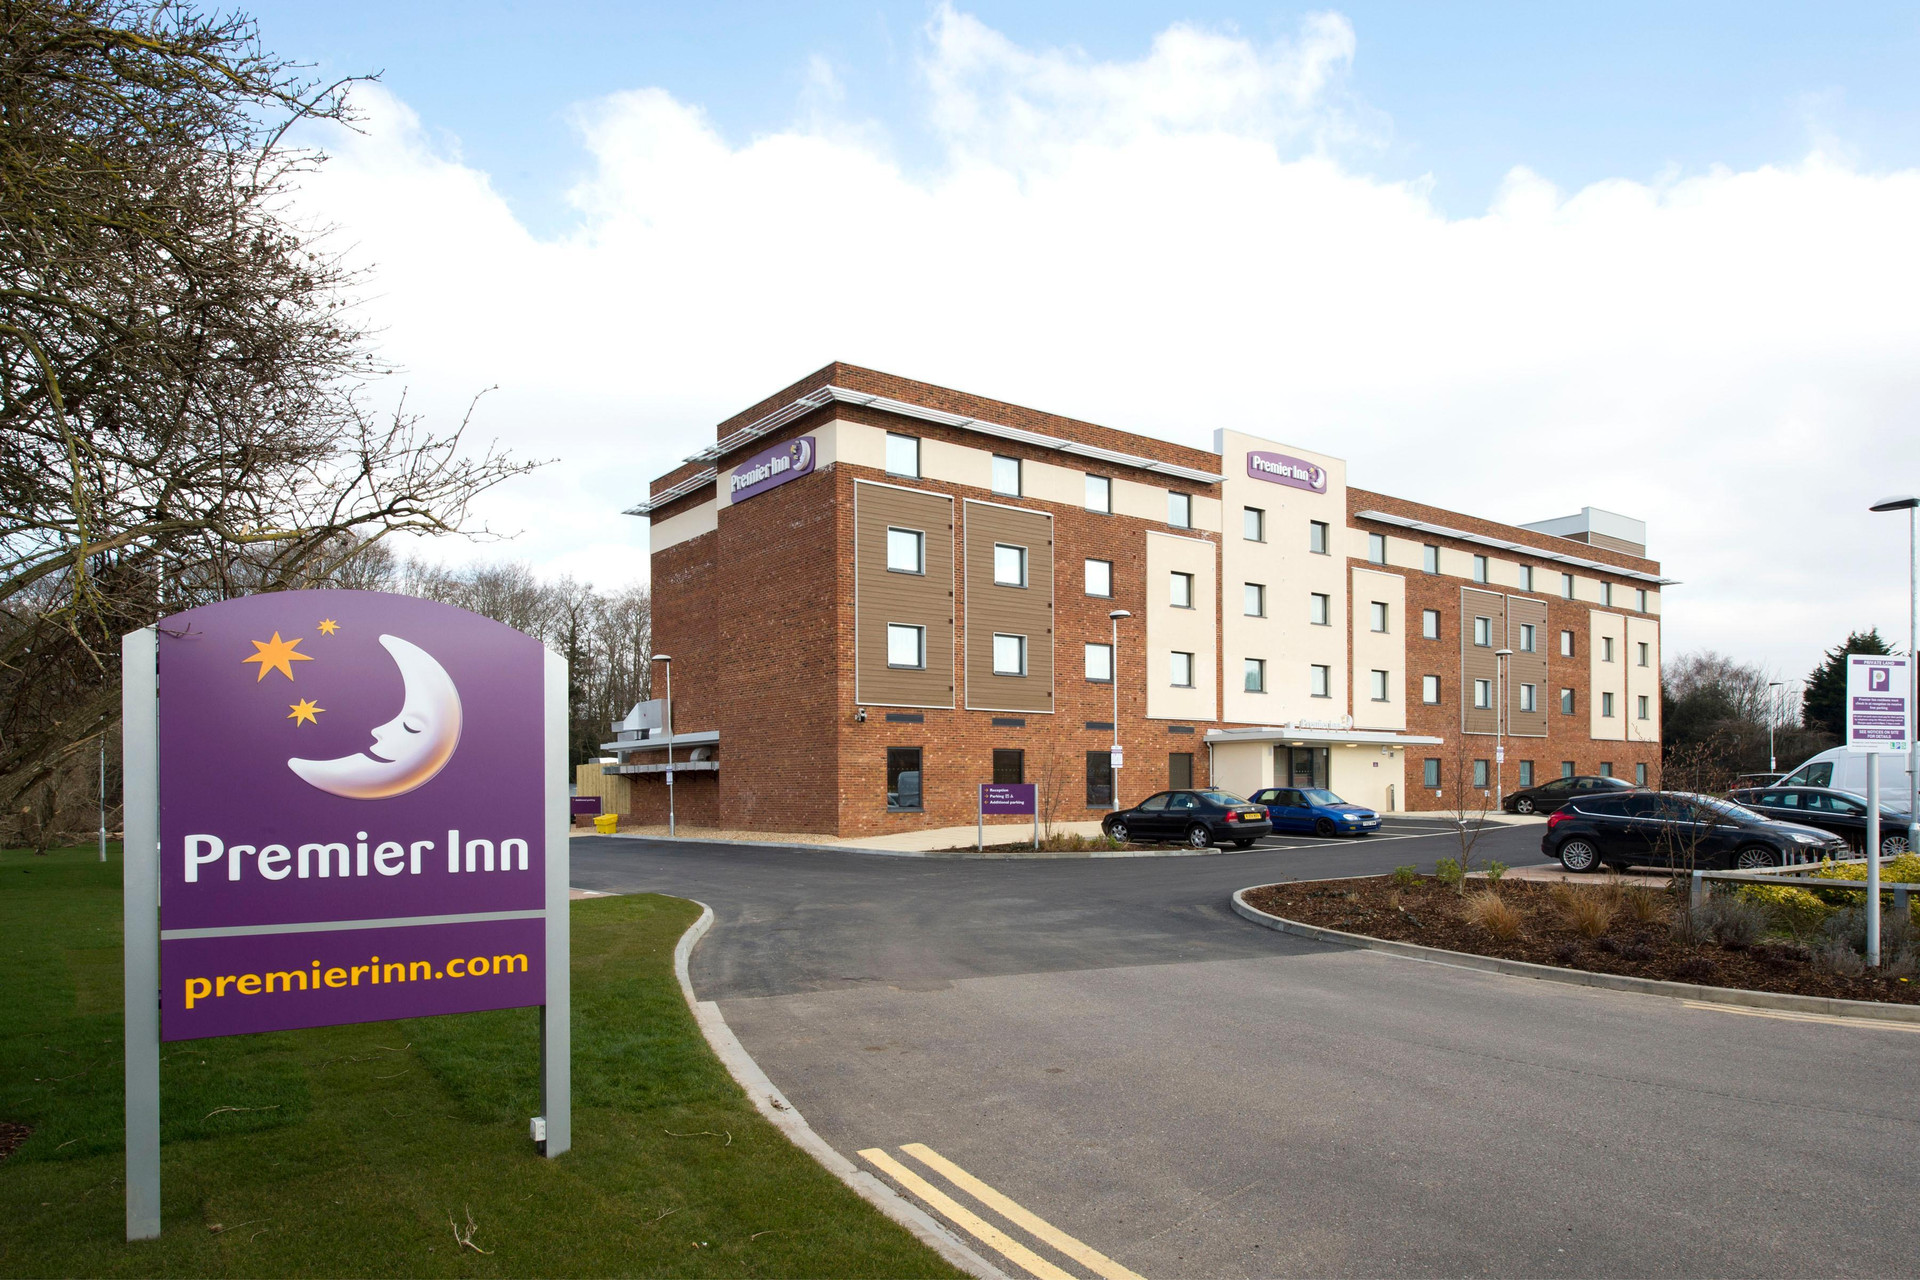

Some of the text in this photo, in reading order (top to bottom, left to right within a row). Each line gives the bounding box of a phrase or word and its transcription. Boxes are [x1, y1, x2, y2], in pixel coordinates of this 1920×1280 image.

[731, 456, 790, 492] Premier Inn
[1252, 455, 1309, 481] Premier Inn
[184, 829, 529, 883] Premier Inn
[184, 952, 529, 1010] premierinn.com
